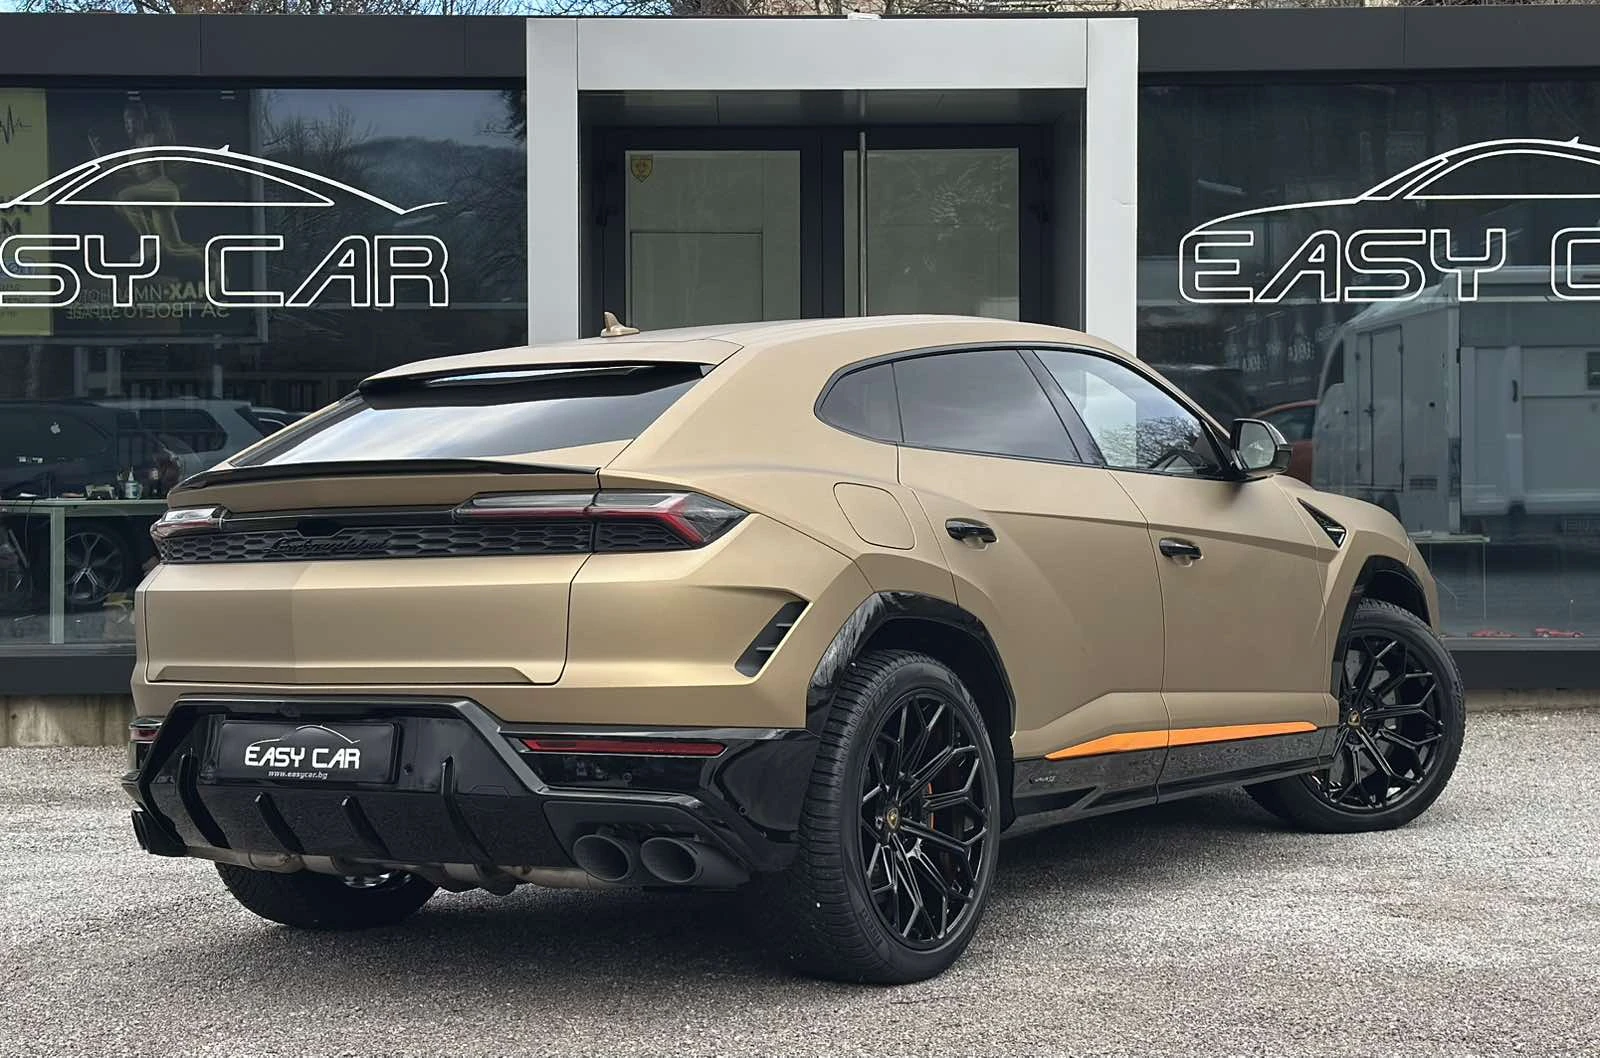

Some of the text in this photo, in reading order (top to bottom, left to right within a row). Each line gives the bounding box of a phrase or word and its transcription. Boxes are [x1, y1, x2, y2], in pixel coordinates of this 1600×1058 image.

[205, 234, 449, 308] CAR
[1179, 228, 1507, 304] EASY
[244, 746, 360, 769] EASY CAR
[267, 770, 328, 780] www.easycar.bg
